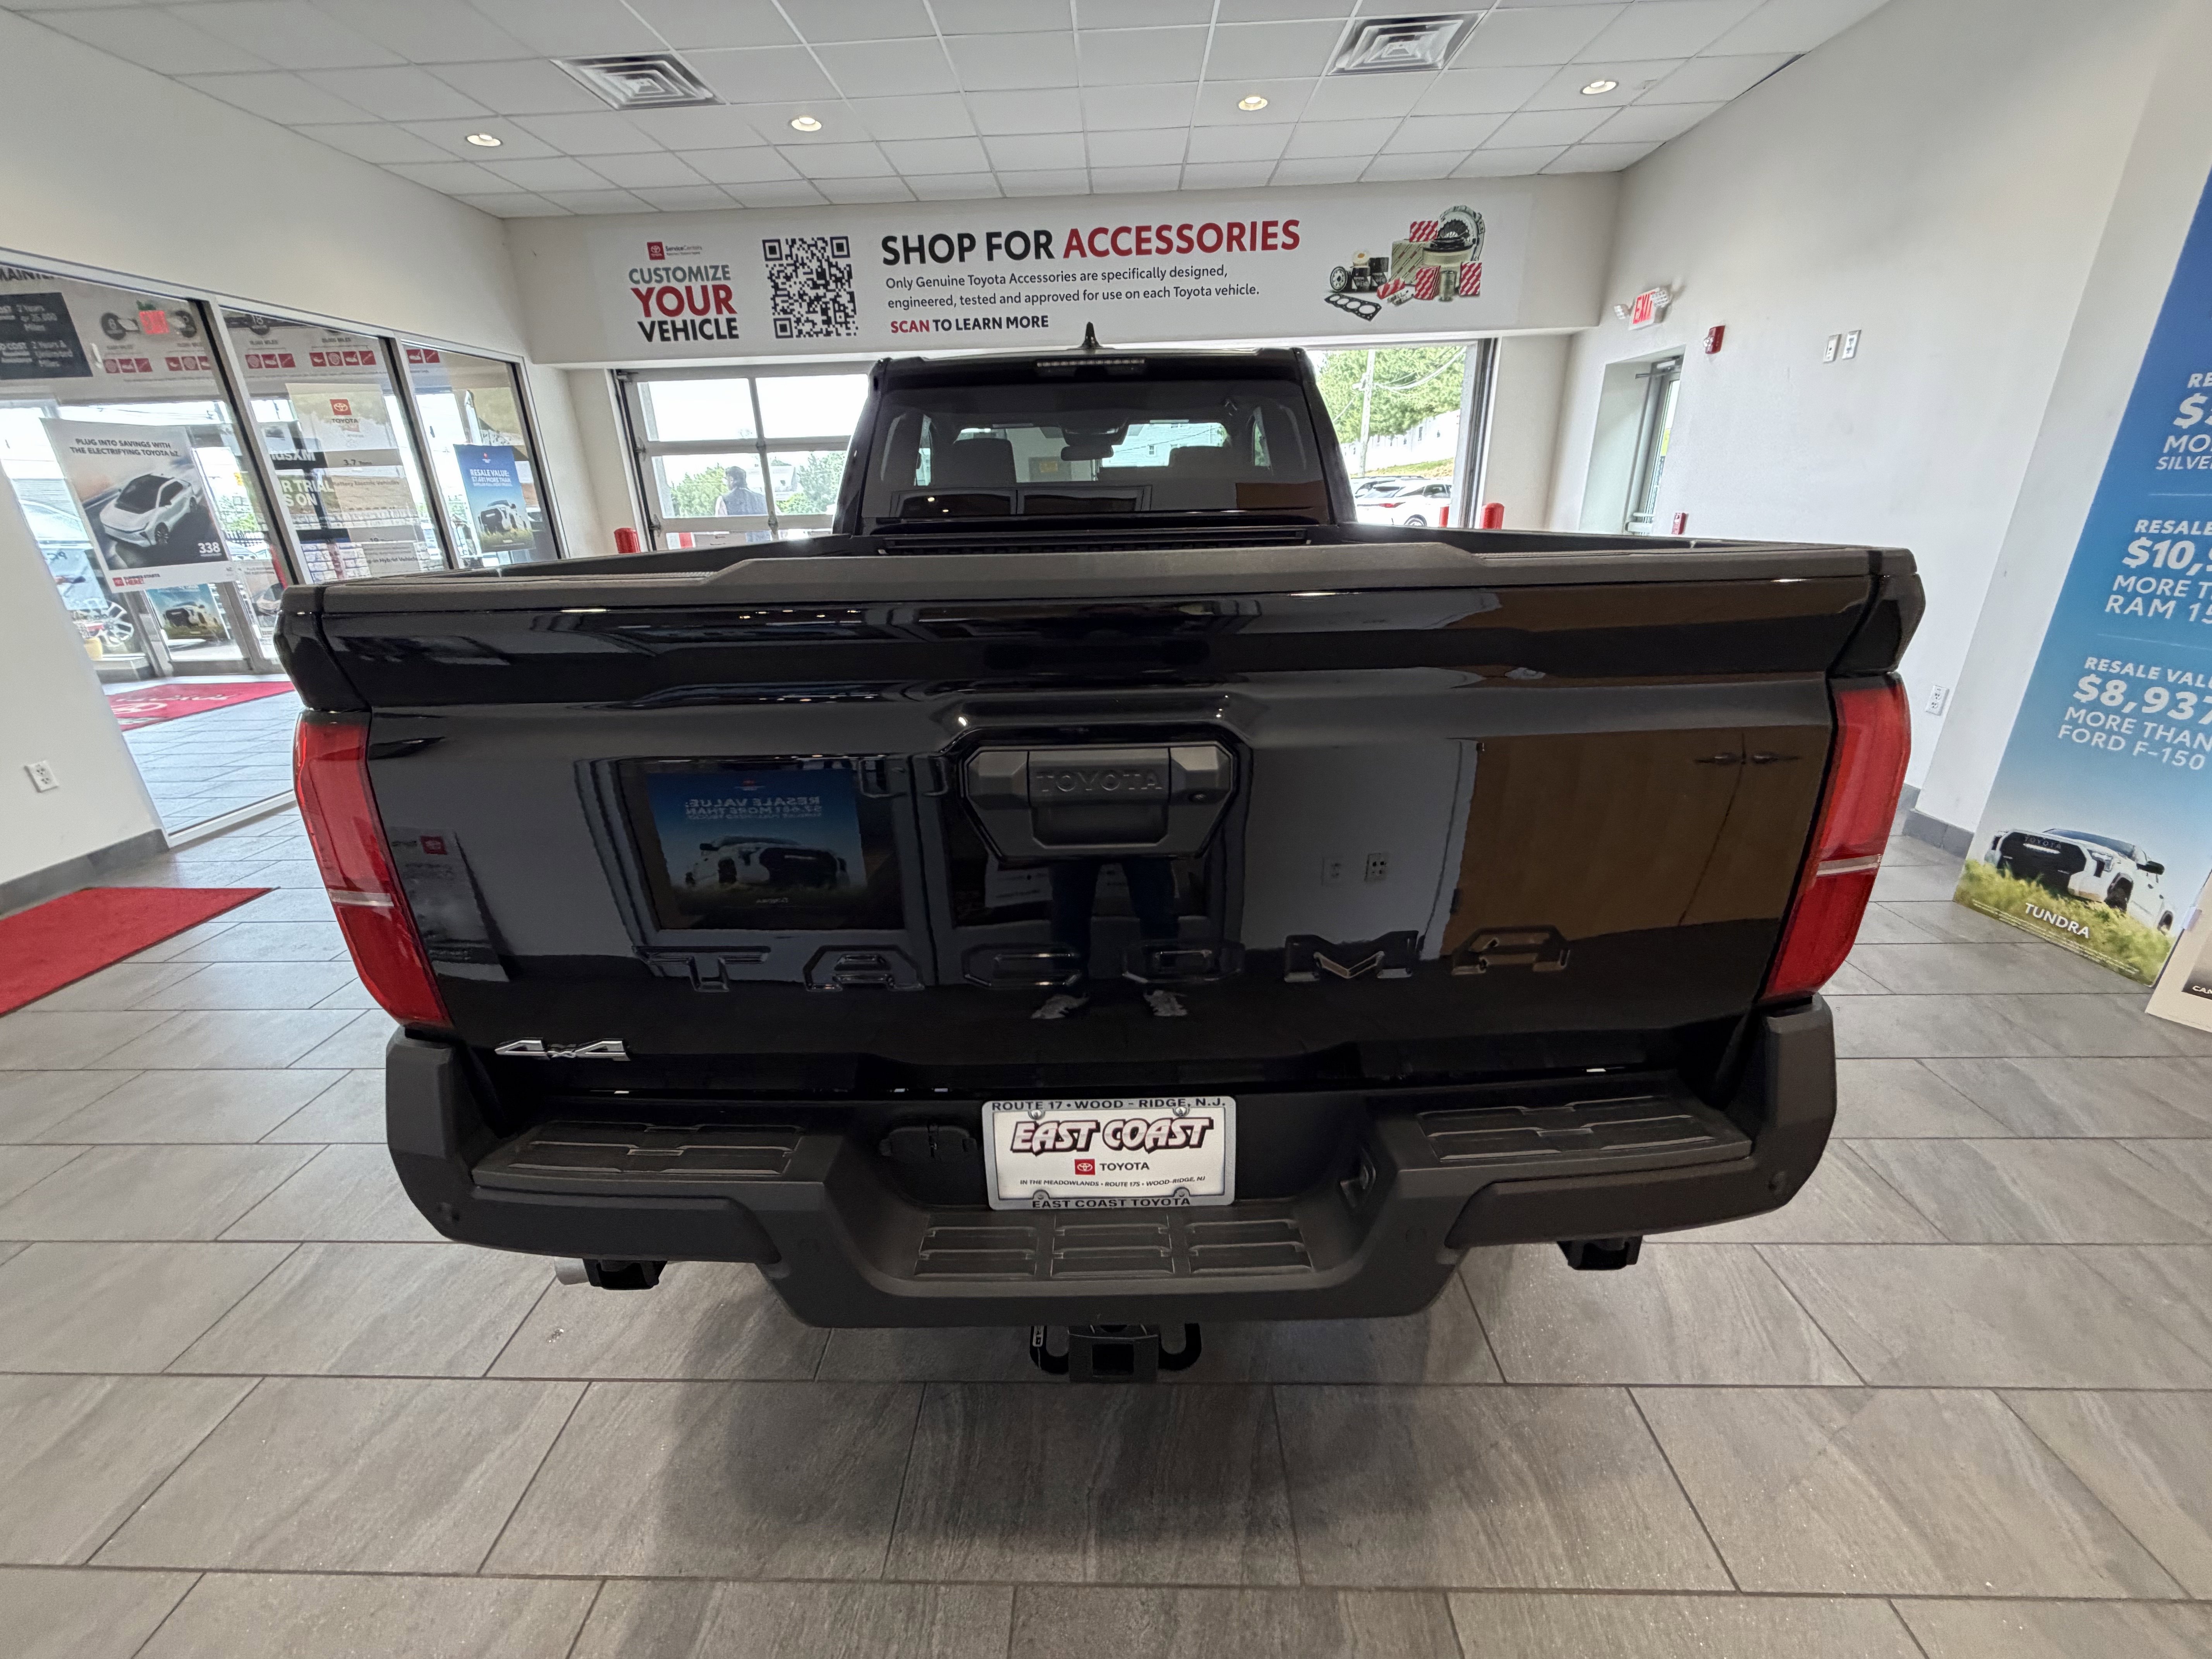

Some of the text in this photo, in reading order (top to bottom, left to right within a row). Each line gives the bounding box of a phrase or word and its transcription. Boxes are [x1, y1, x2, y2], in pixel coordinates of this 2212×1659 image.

[881, 220, 1300, 266] SHOP FOR ACCESSORIES
[629, 264, 732, 285] CUSTOMIZE
[886, 264, 1228, 290] Only Genuine Toyota Accessories are specifically designed,
[630, 284, 738, 318] YOUR
[888, 283, 1259, 310] engineered, tested and approved for use on each Toyota vehicle.
[1632, 291, 1656, 325] EXIT
[637, 318, 740, 343] VEHICLE
[891, 315, 1049, 333] SCAN TO LEARN MORE
[88, 447, 141, 456] ELECTRIFYING
[2163, 434, 2212, 453] MO
[2155, 456, 2212, 470] SILVE
[280, 480, 335, 493] R TRIAL
[295, 493, 318, 506] ON
[2134, 519, 2212, 536] RESALE
[198, 542, 221, 554] 338
[2112, 575, 2212, 599] MORE T
[2105, 595, 2176, 619] RAM
[2084, 657, 2162, 680] RESALE
[2073, 673, 2212, 725] $8,937
[2064, 707, 2212, 752] MORE THAN
[2058, 725, 2206, 770] FORD F-150
[1036, 771, 1163, 792] TOYOTA
[2025, 835, 2061, 850] TOYOTA
[2025, 903, 2090, 939] TUNDRA
[631, 926, 1571, 993] TACOMA
[992, 1101, 1043, 1111] ROUTE
[1048, 1101, 1062, 1109] 17
[1074, 1100, 1123, 1109] WOOD
[1139, 1098, 1191, 1108] RIDGE,
[1195, 1097, 1226, 1106] N.J.
[1010, 1117, 1214, 1157] EAST COAST
[1099, 1162, 1150, 1171] TOYOTA
[1032, 1198, 1190, 1208] EAST COAST TOYOTA
